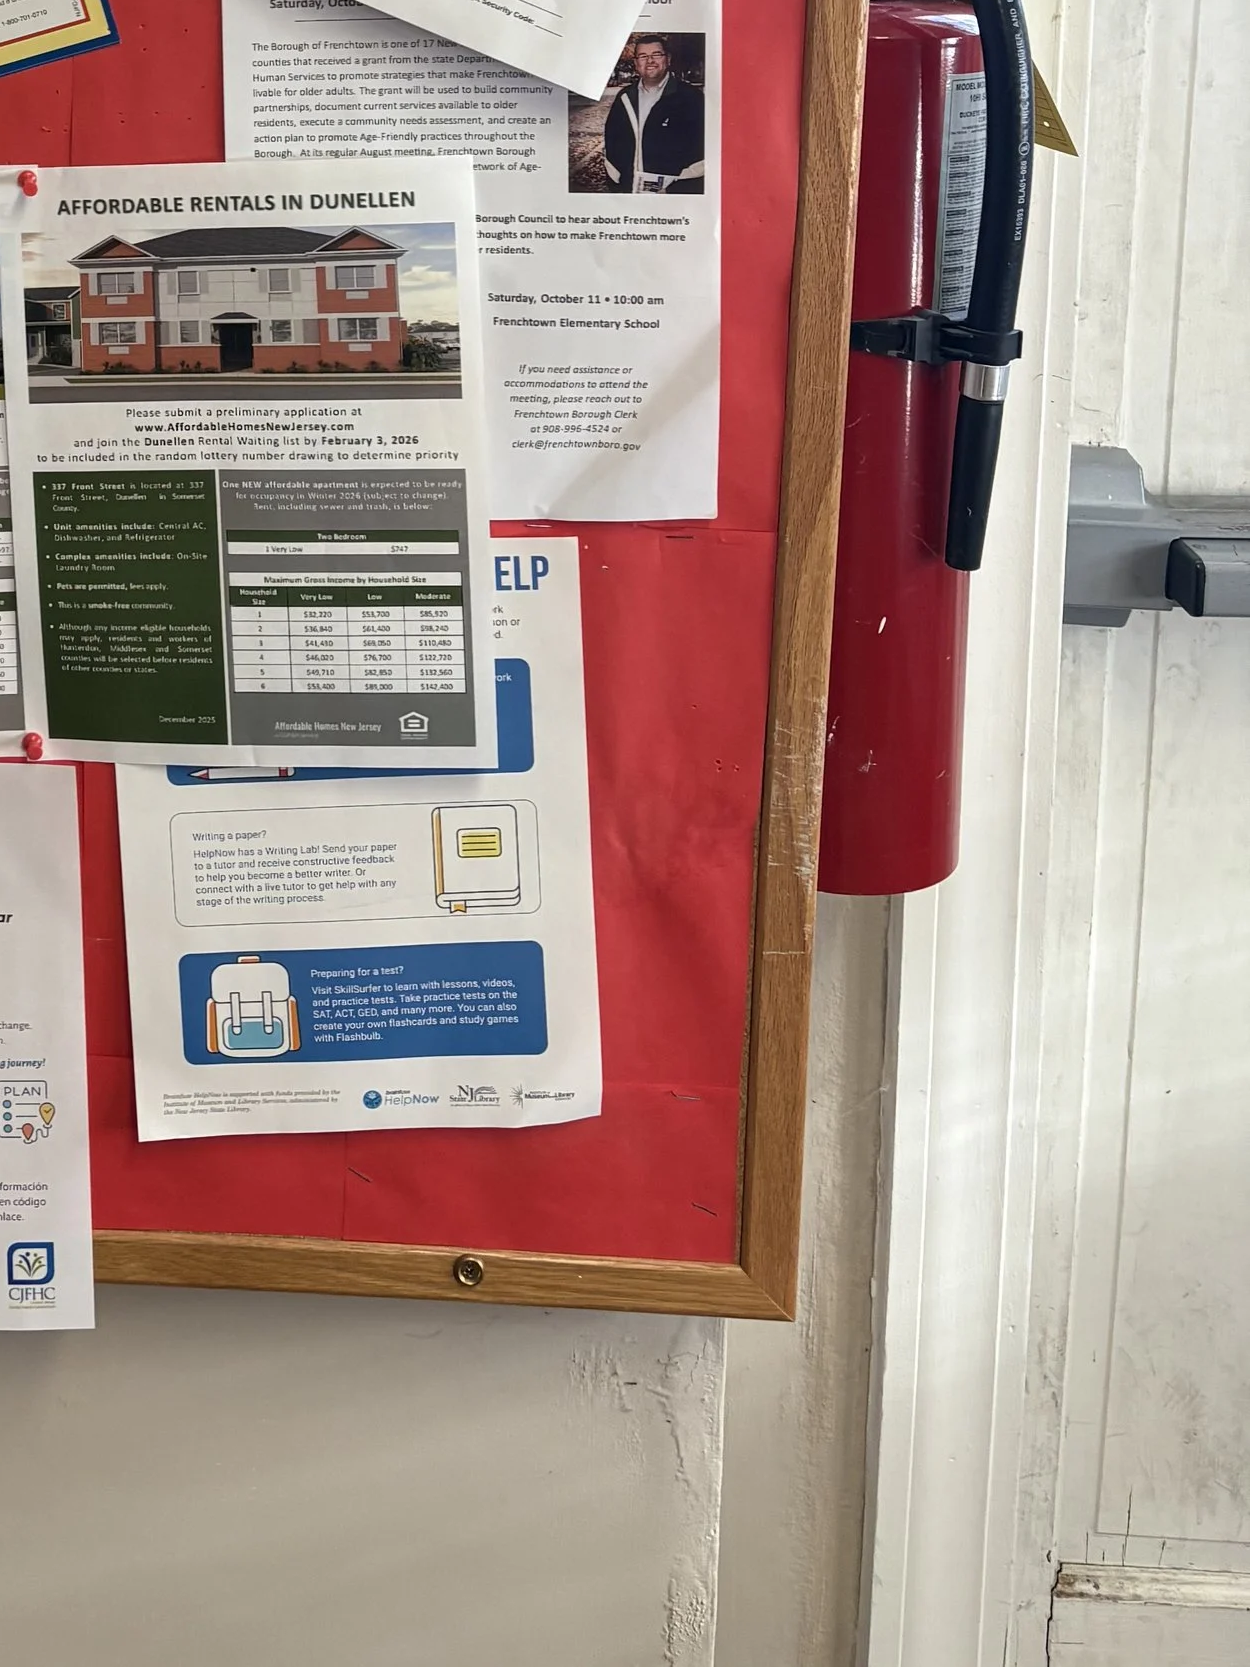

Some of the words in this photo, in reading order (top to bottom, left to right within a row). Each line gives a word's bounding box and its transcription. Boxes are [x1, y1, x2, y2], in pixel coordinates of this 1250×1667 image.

[1009, 8, 1020, 28] AND
[57, 197, 184, 216] AFFORDABLE
[190, 194, 276, 213] RENTALS
[281, 194, 303, 211] IN
[310, 191, 415, 210] DUNELLEN
[487, 292, 537, 305] Saturday,
[540, 293, 584, 304] October
[588, 294, 601, 304] 11
[613, 295, 644, 305] 10:00
[647, 297, 664, 305] am
[493, 316, 557, 327] Frenchtown
[559, 317, 621, 331] Elementary
[623, 319, 660, 329] School
[495, 555, 550, 592] ELP
[310, 969, 356, 980] Preparing
[357, 967, 371, 977] for
[372, 968, 380, 976] a
[380, 965, 404, 975] test?
[4, 1085, 41, 1097] PLAN
[384, 1094, 440, 1107] HelpNow
[8, 1287, 56, 1303] CJFHC
